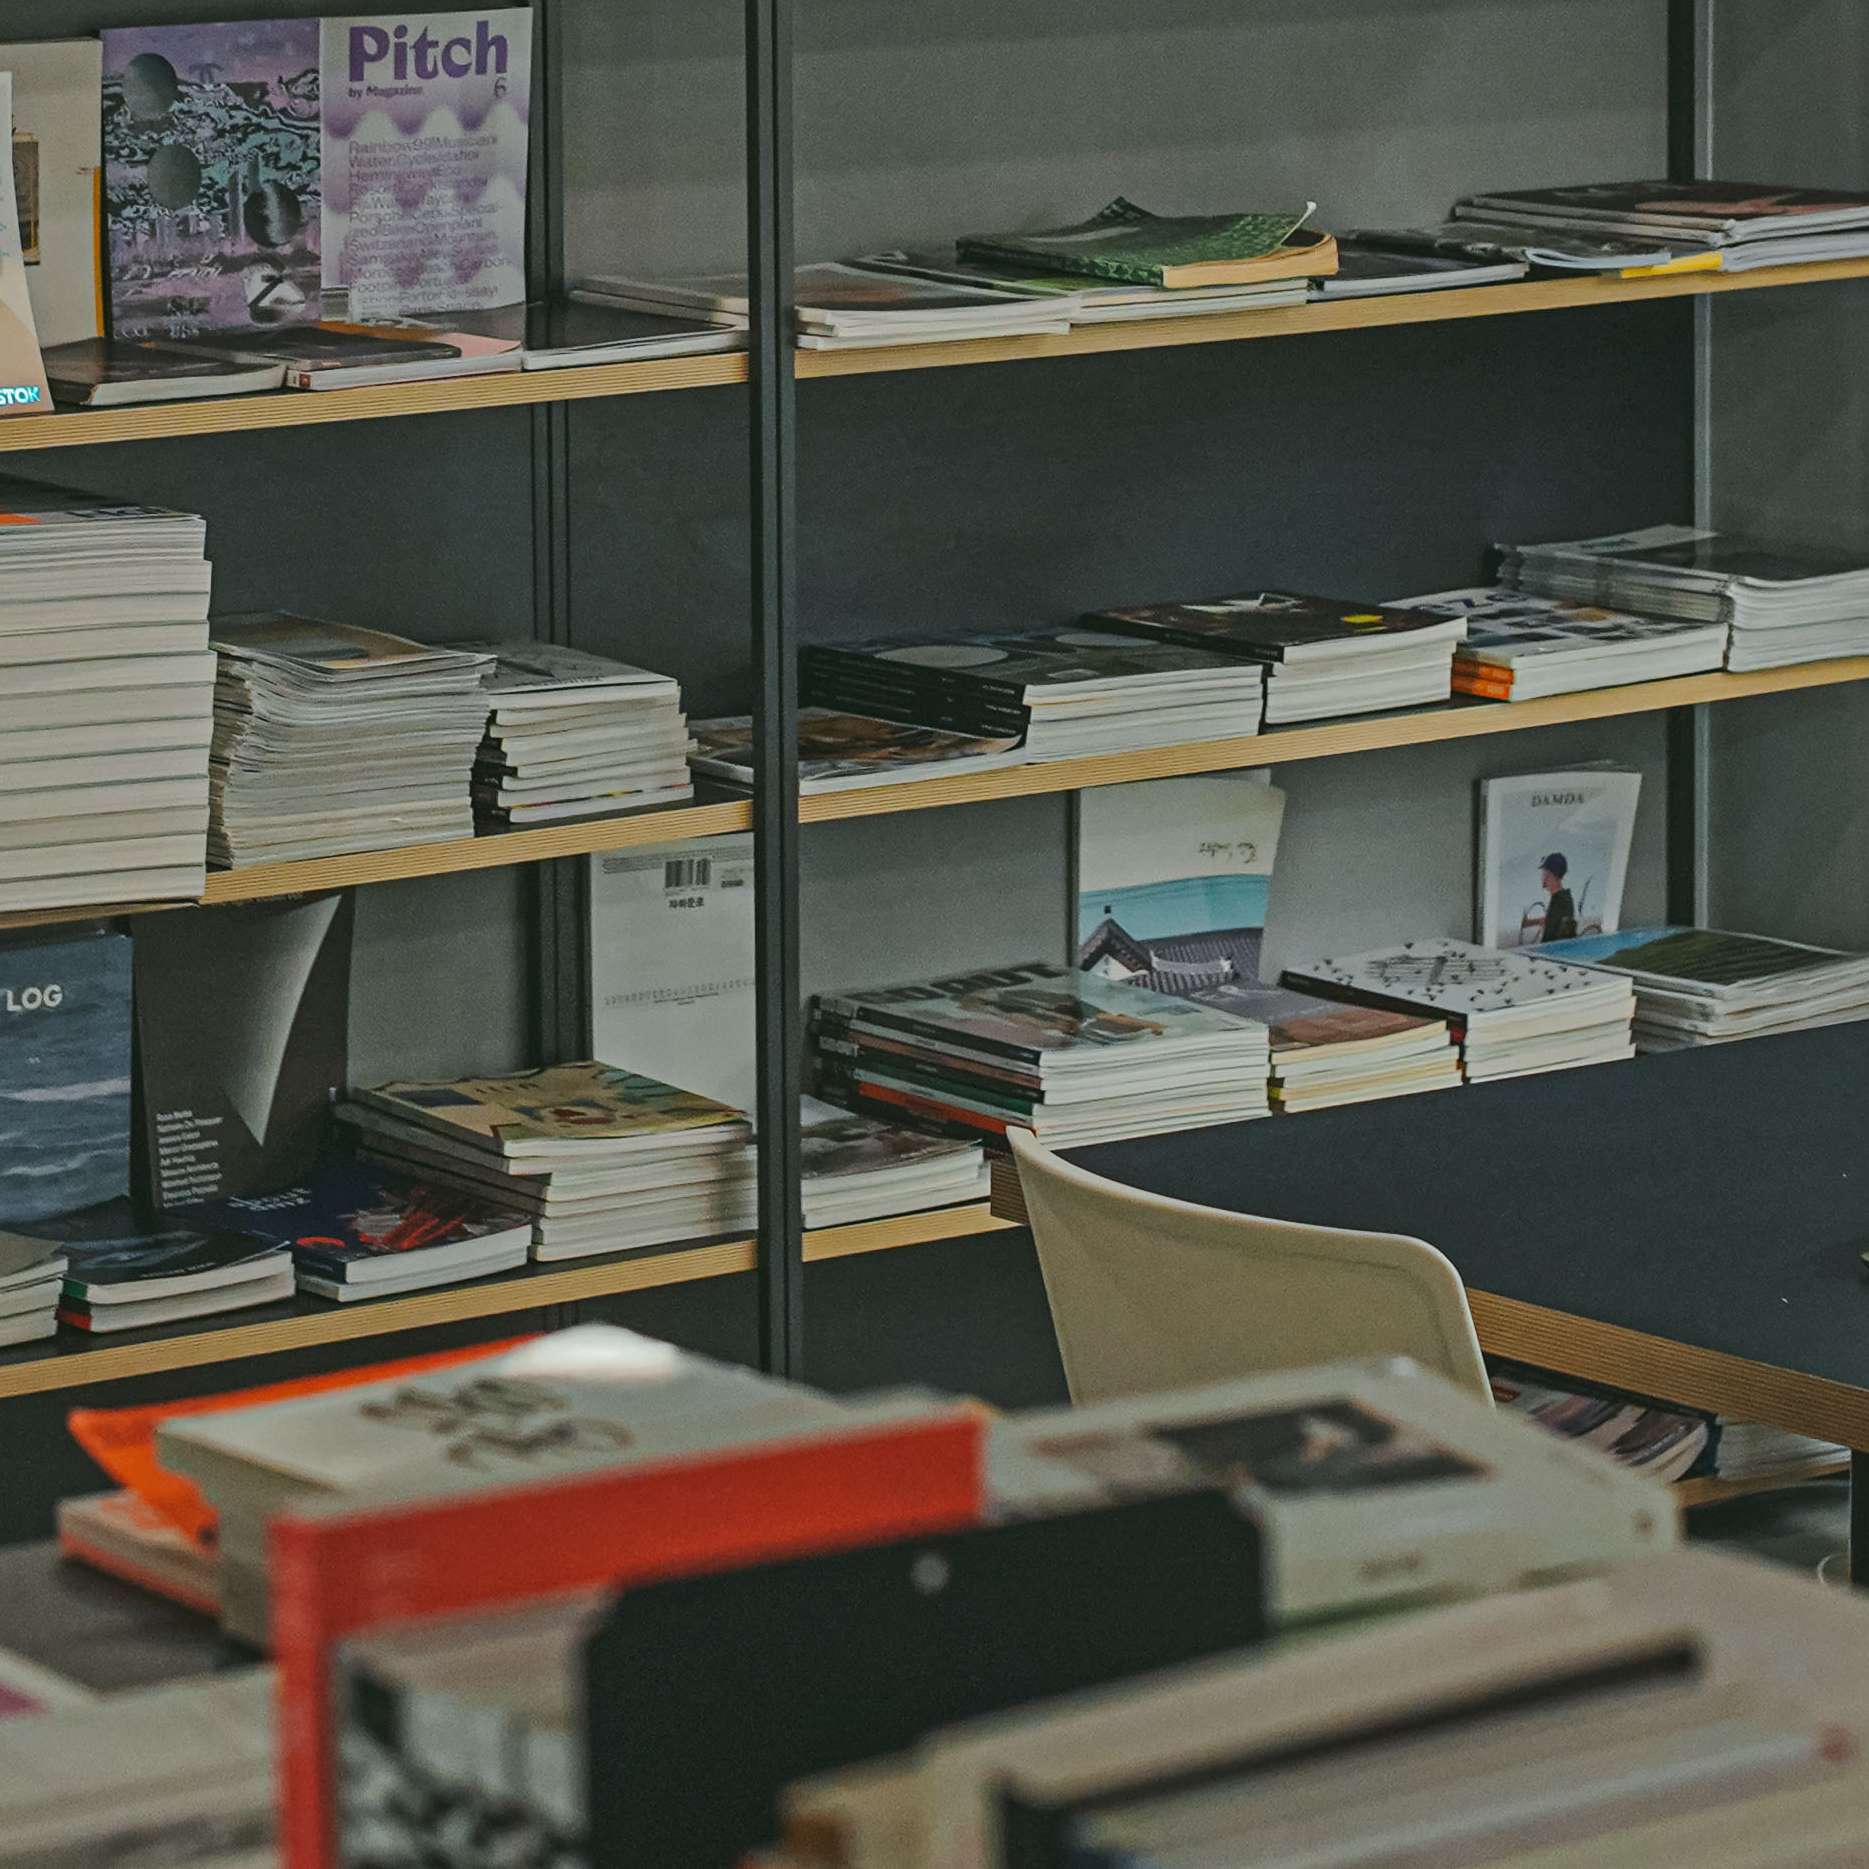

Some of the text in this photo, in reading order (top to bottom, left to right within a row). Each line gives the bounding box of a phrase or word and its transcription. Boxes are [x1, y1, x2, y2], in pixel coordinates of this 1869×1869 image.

[349, 20, 508, 82] Pitch
[366, 83, 424, 99] Magazine
[5, 983, 63, 1012] LOG
